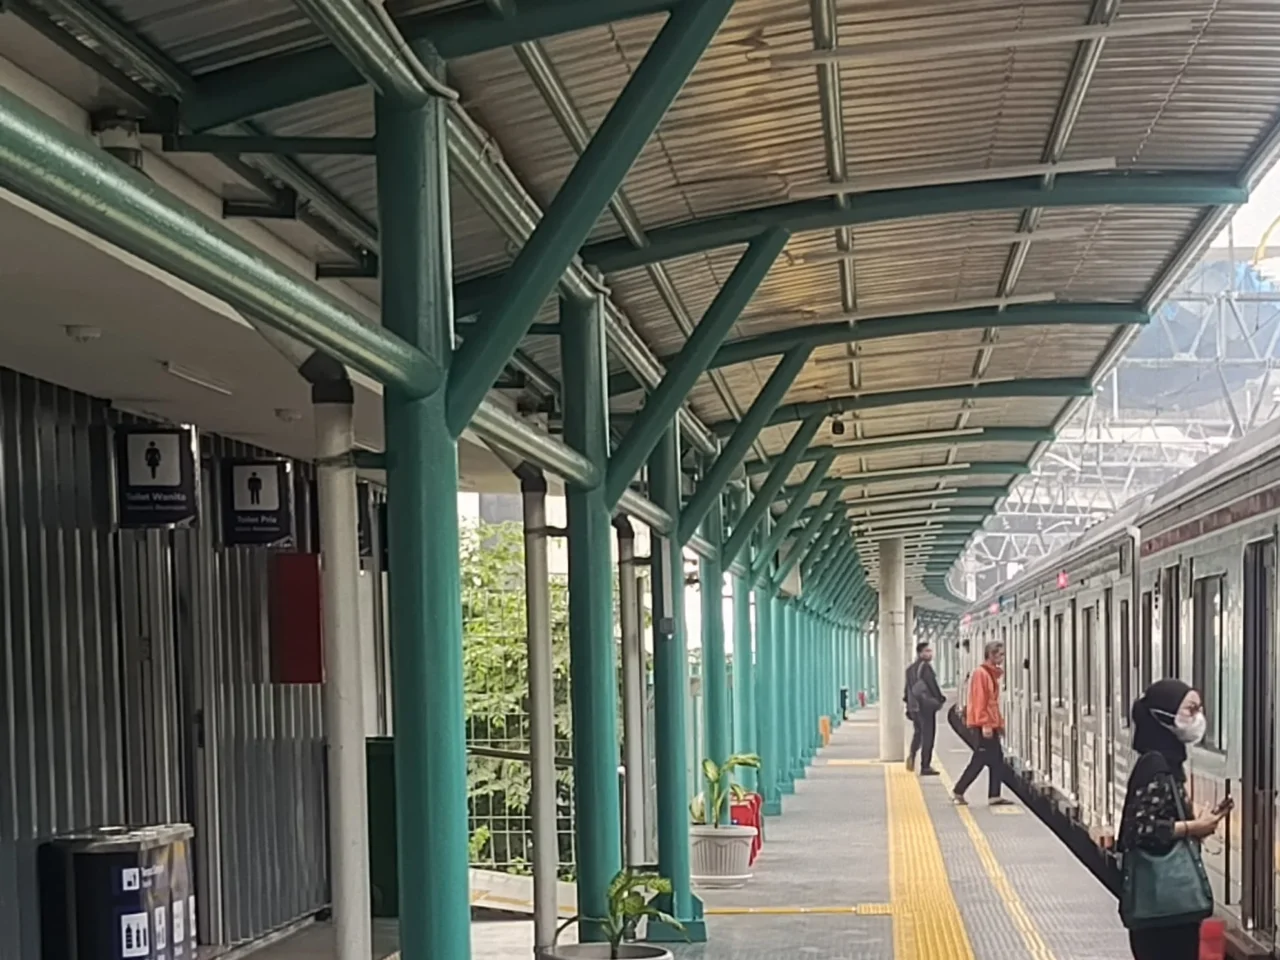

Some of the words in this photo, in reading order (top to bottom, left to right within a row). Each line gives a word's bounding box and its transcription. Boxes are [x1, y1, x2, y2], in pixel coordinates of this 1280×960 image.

[126, 493, 150, 501] Toilet
[152, 492, 187, 501] Wanita
[261, 515, 277, 524] Pria
